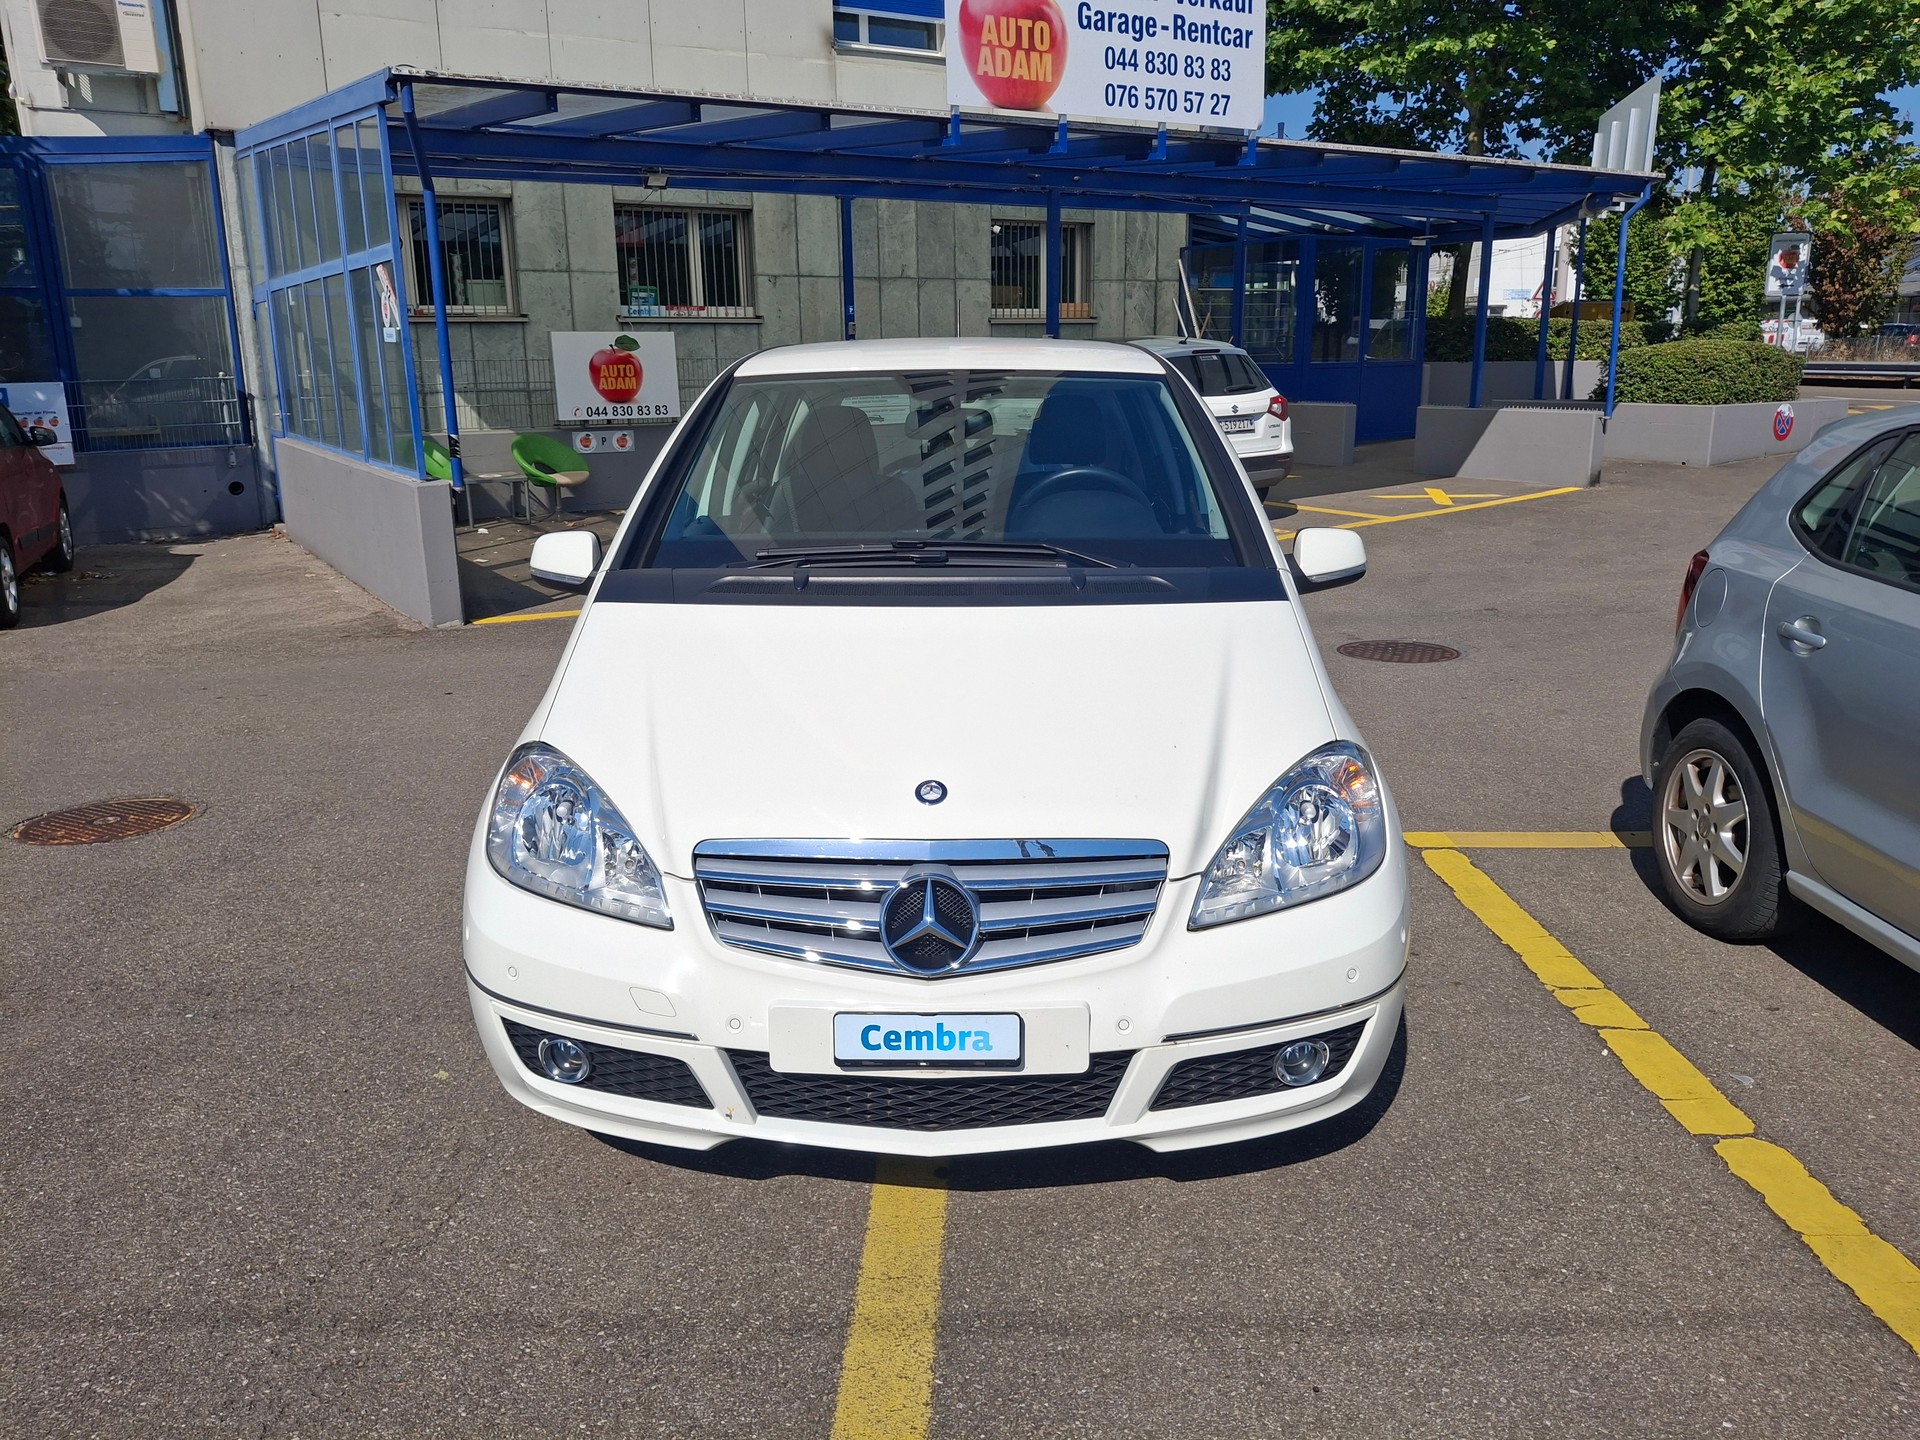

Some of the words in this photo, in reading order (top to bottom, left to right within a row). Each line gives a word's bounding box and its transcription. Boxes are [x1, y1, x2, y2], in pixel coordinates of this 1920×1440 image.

[981, 15, 1050, 51] AUTO
[976, 46, 1052, 82] ADAM
[1104, 46, 1139, 72] 044
[1145, 49, 1178, 76] 830
[1184, 54, 1205, 79] 83
[1210, 57, 1231, 82] 83
[1104, 83, 1139, 109] 076
[1145, 87, 1178, 112] 570
[1183, 90, 1205, 114] 57
[1210, 93, 1231, 116] 27
[599, 377, 637, 390] ADAM
[600, 364, 635, 378] AUTO
[586, 406, 608, 417] 044
[612, 405, 633, 416] 830
[637, 405, 651, 416] 83
[654, 405, 669, 415] 83
[861, 1022, 993, 1051] Cembra
